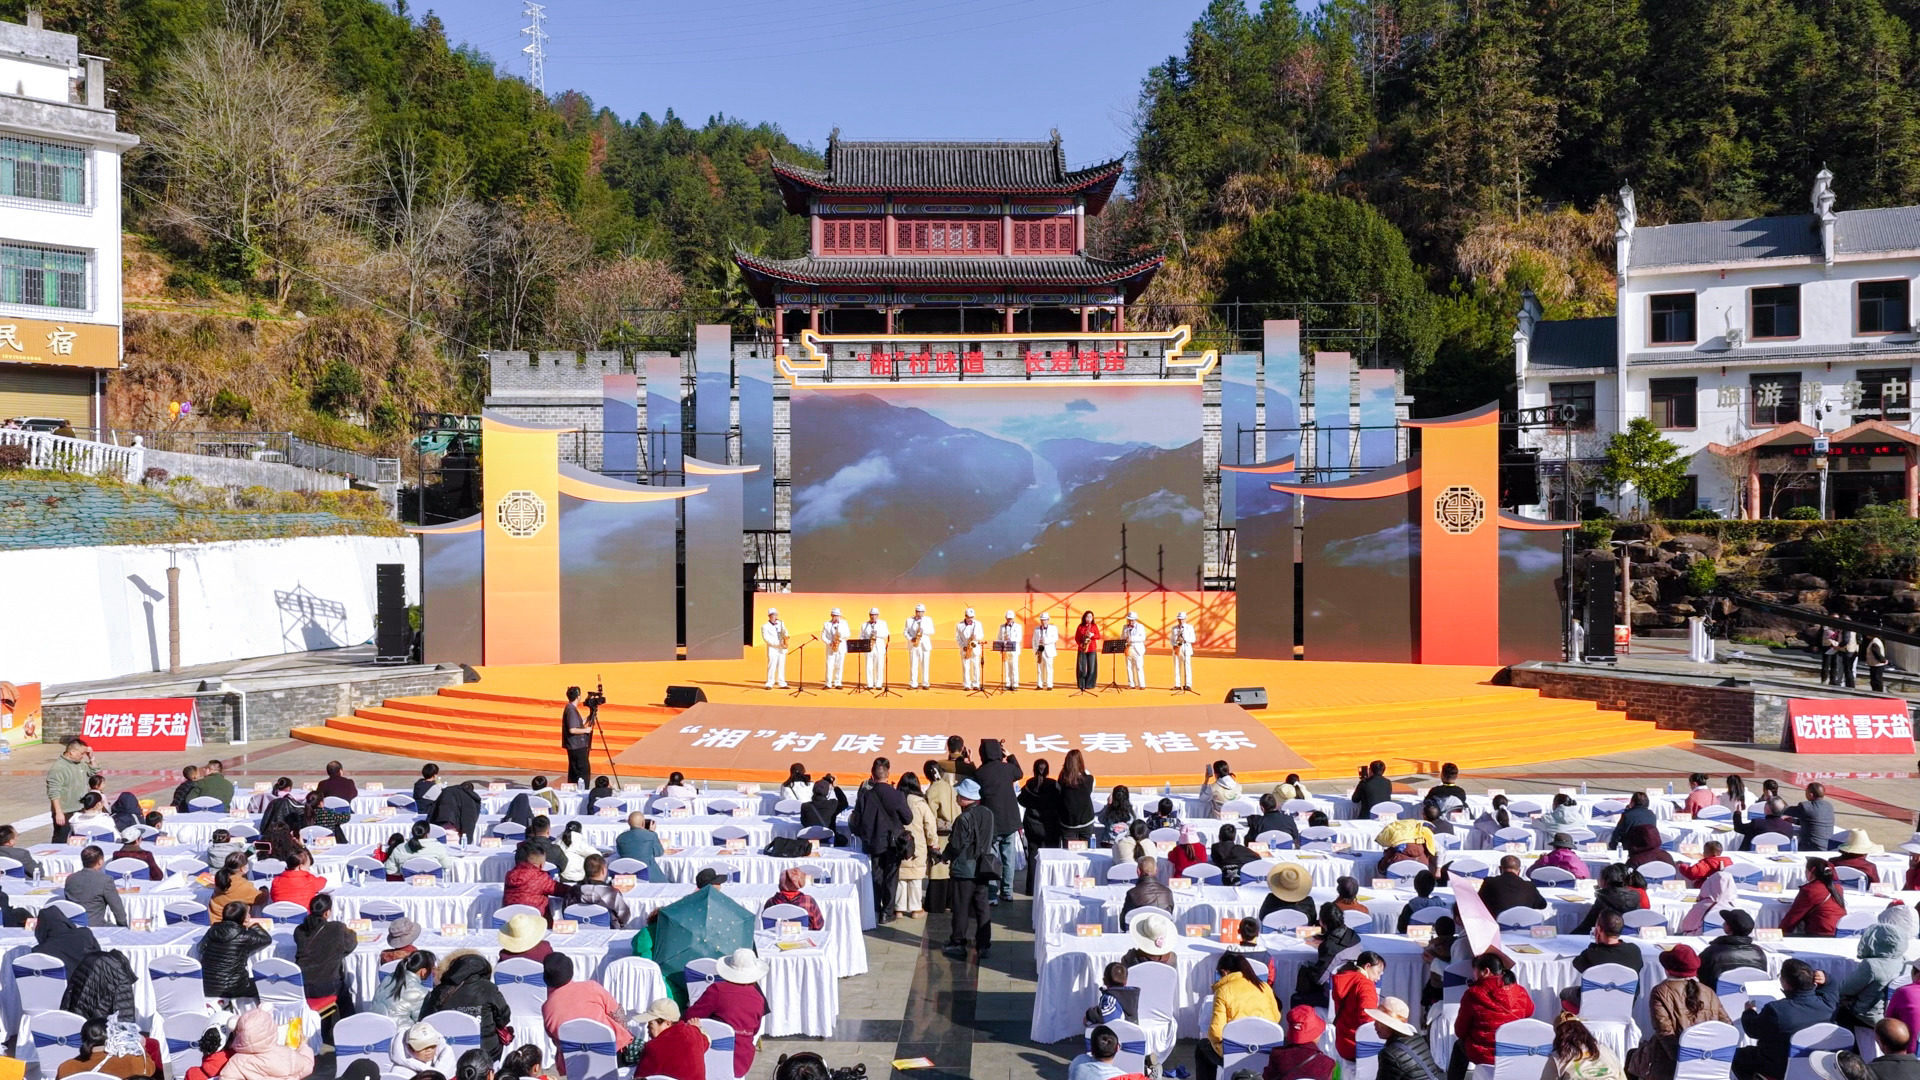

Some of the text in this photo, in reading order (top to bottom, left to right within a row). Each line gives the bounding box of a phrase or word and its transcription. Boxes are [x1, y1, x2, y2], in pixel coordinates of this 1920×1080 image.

[0, 323, 78, 356] 民宿
[1024, 350, 1126, 373] 长寿桂东
[83, 712, 188, 738] 吃好盐 雪天盐
[1794, 714, 1912, 739] 吃好盐 雪天盐
[1019, 729, 1257, 754] 长寿桂东
